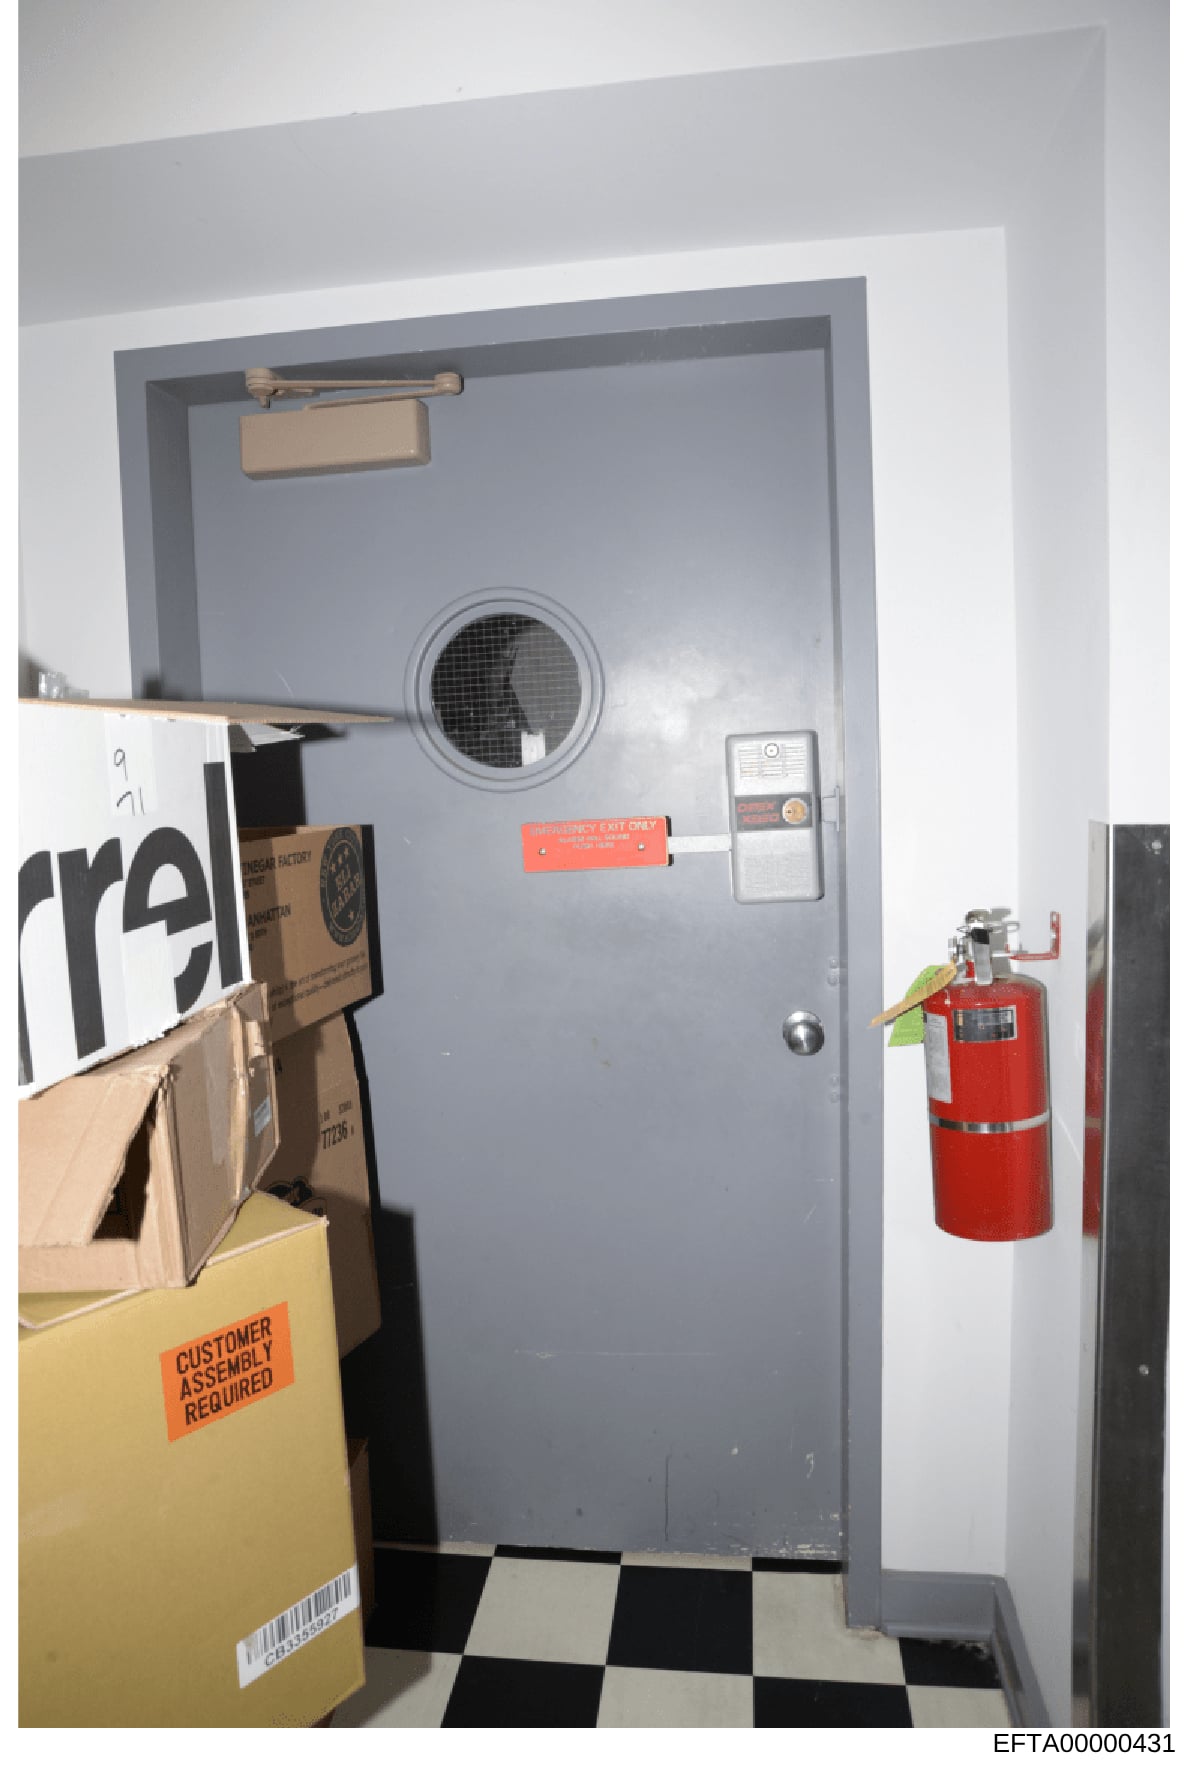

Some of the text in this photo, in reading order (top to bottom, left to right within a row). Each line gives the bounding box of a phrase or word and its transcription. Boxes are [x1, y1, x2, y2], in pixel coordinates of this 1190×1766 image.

[600, 821, 625, 833] EXIT
[628, 820, 657, 831] ONLY
[278, 851, 312, 867] FACTORY
[176, 1316, 273, 1375] CUSTOMER
[180, 1340, 273, 1401] ASSEMBLY
[185, 1367, 273, 1426] REQUIRED
[264, 1607, 339, 1667] CB3355927
